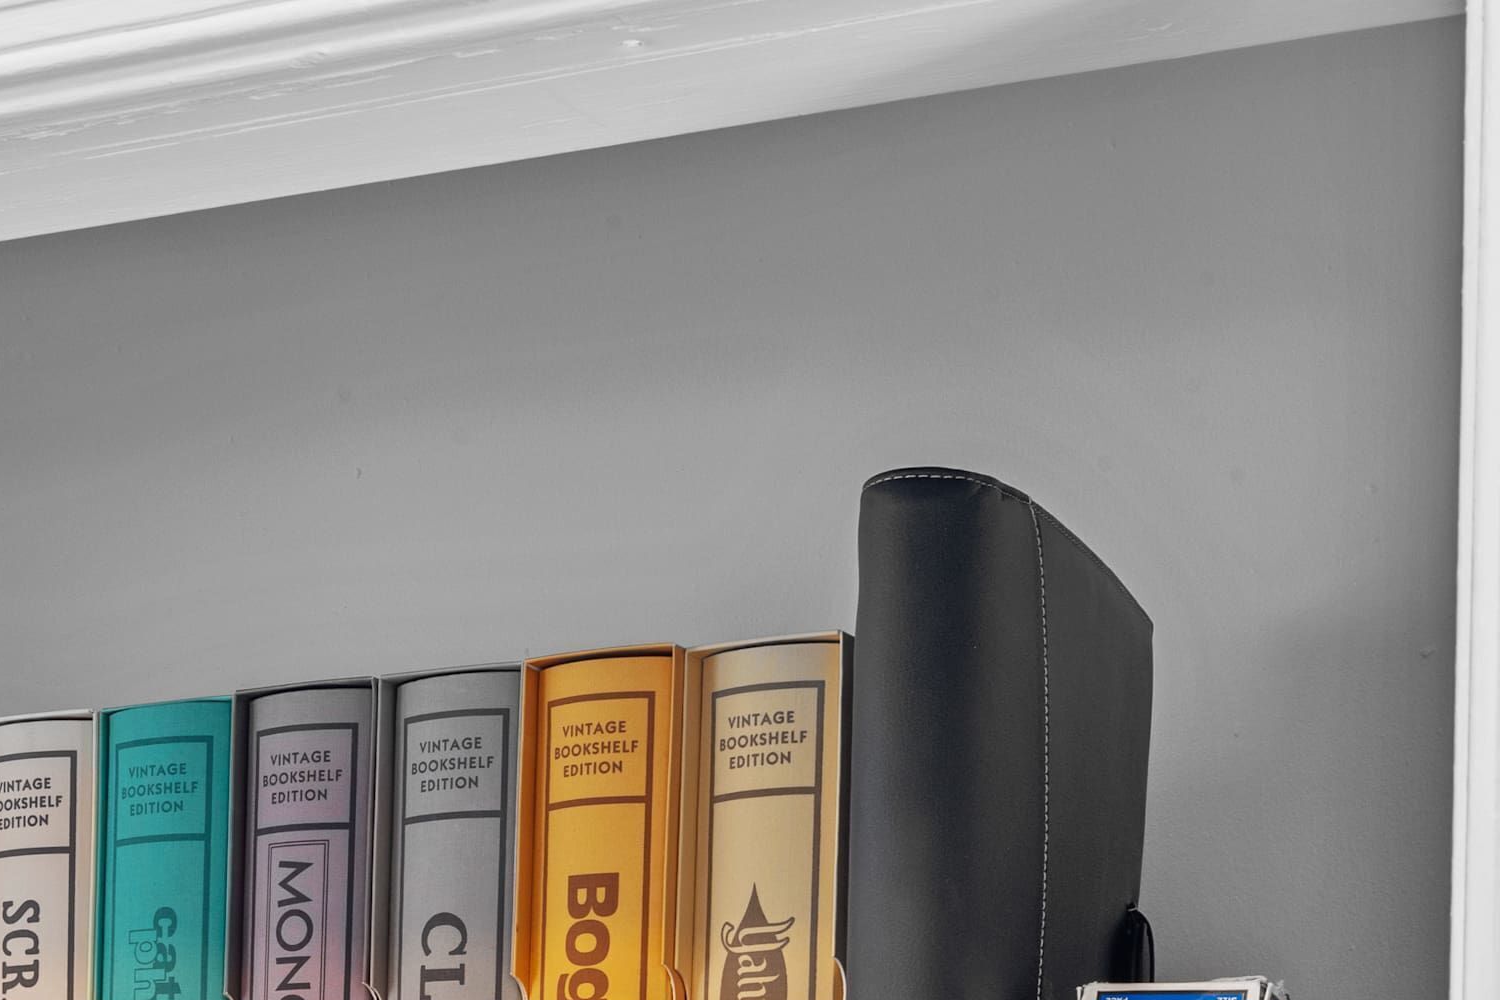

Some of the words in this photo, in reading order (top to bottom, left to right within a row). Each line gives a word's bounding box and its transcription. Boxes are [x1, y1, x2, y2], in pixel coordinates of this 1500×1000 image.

[728, 710, 795, 729] VINTAGE
[562, 720, 627, 738] VINTAGE
[419, 737, 482, 753] VINTAGE
[554, 740, 639, 760] BOOKSHELF
[719, 730, 808, 752] BOOKSHELF
[270, 750, 331, 766] VINTAGE
[411, 756, 494, 775] BOOKSHELF
[729, 751, 792, 770] EDITION
[128, 762, 187, 779] VINTAGE
[262, 769, 343, 787] BOOKSHELF
[563, 760, 623, 778] EDITION
[121, 781, 199, 800] BOOKSHELF
[420, 775, 479, 792] EDITION
[271, 788, 328, 805] EDITION
[129, 800, 184, 817] EDITION
